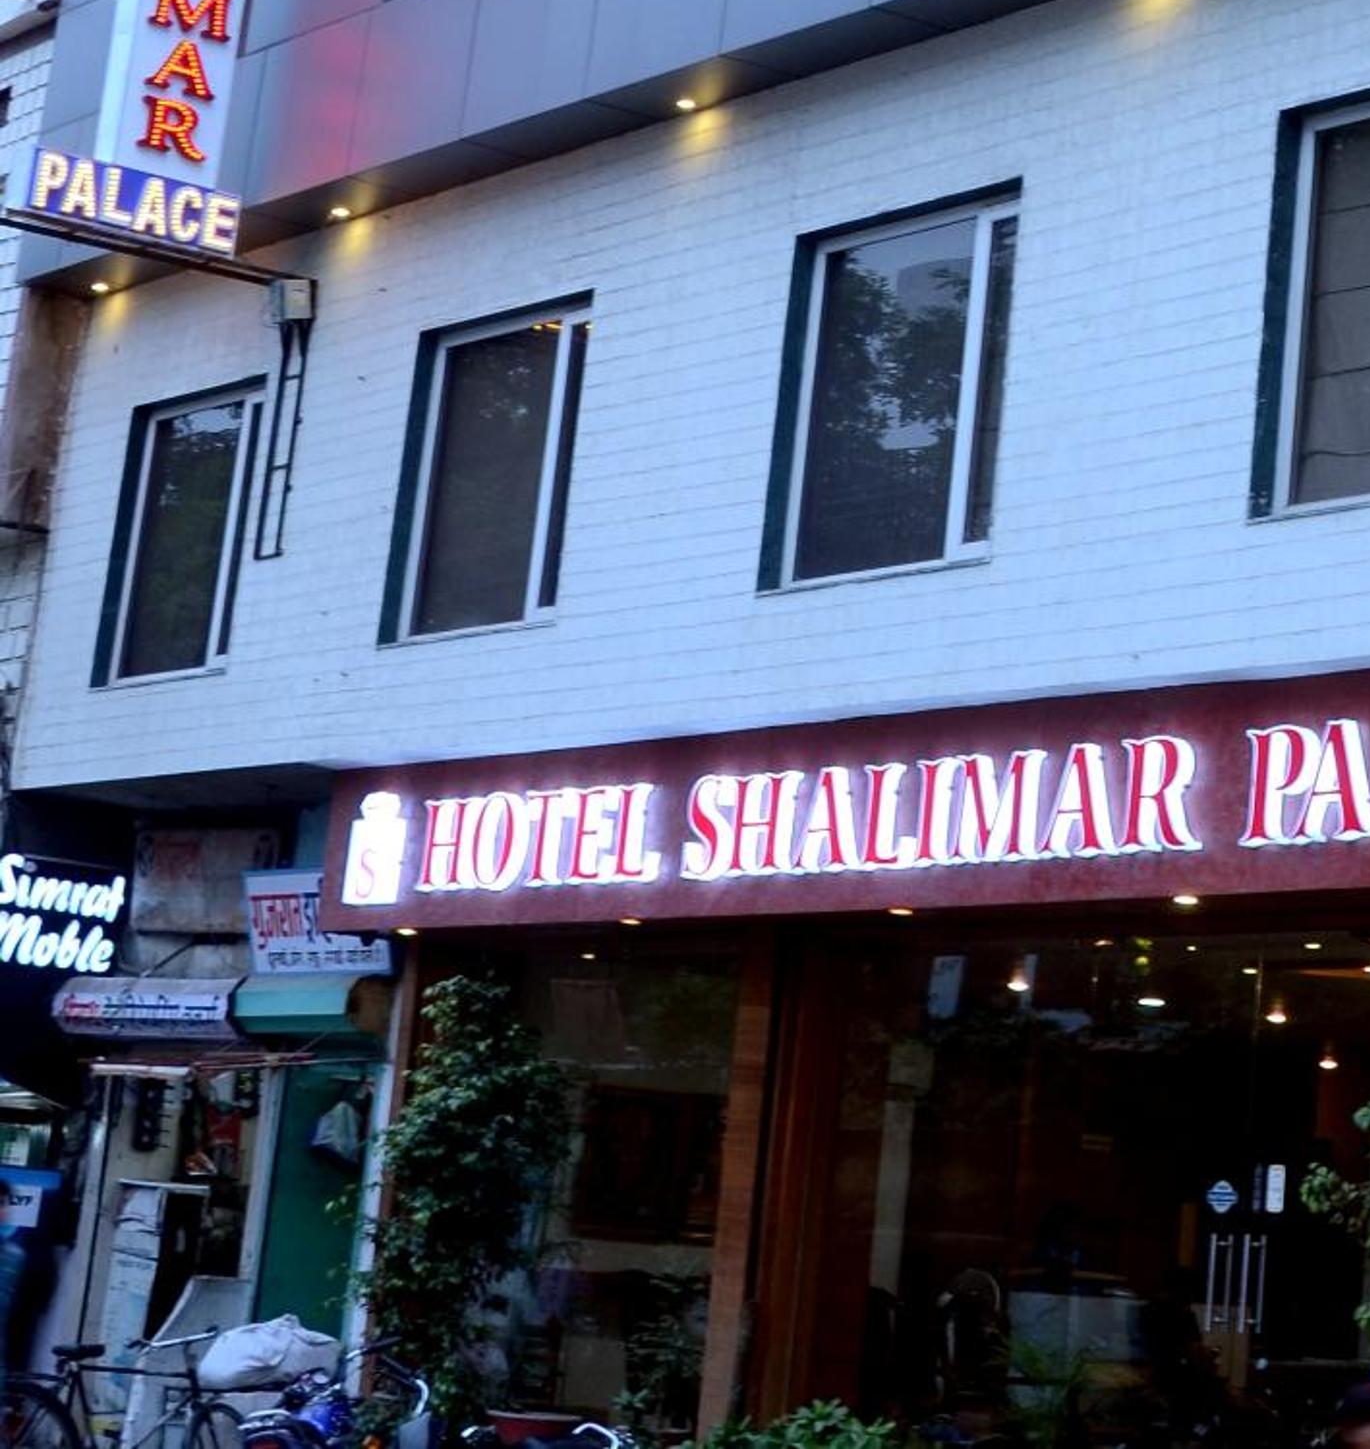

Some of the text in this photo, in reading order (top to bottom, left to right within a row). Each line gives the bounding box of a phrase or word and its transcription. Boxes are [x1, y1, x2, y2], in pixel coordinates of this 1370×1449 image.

[31, 152, 239, 252] PALACE
[415, 782, 663, 892] HOTEL
[680, 735, 1203, 881] SHALIMAR
